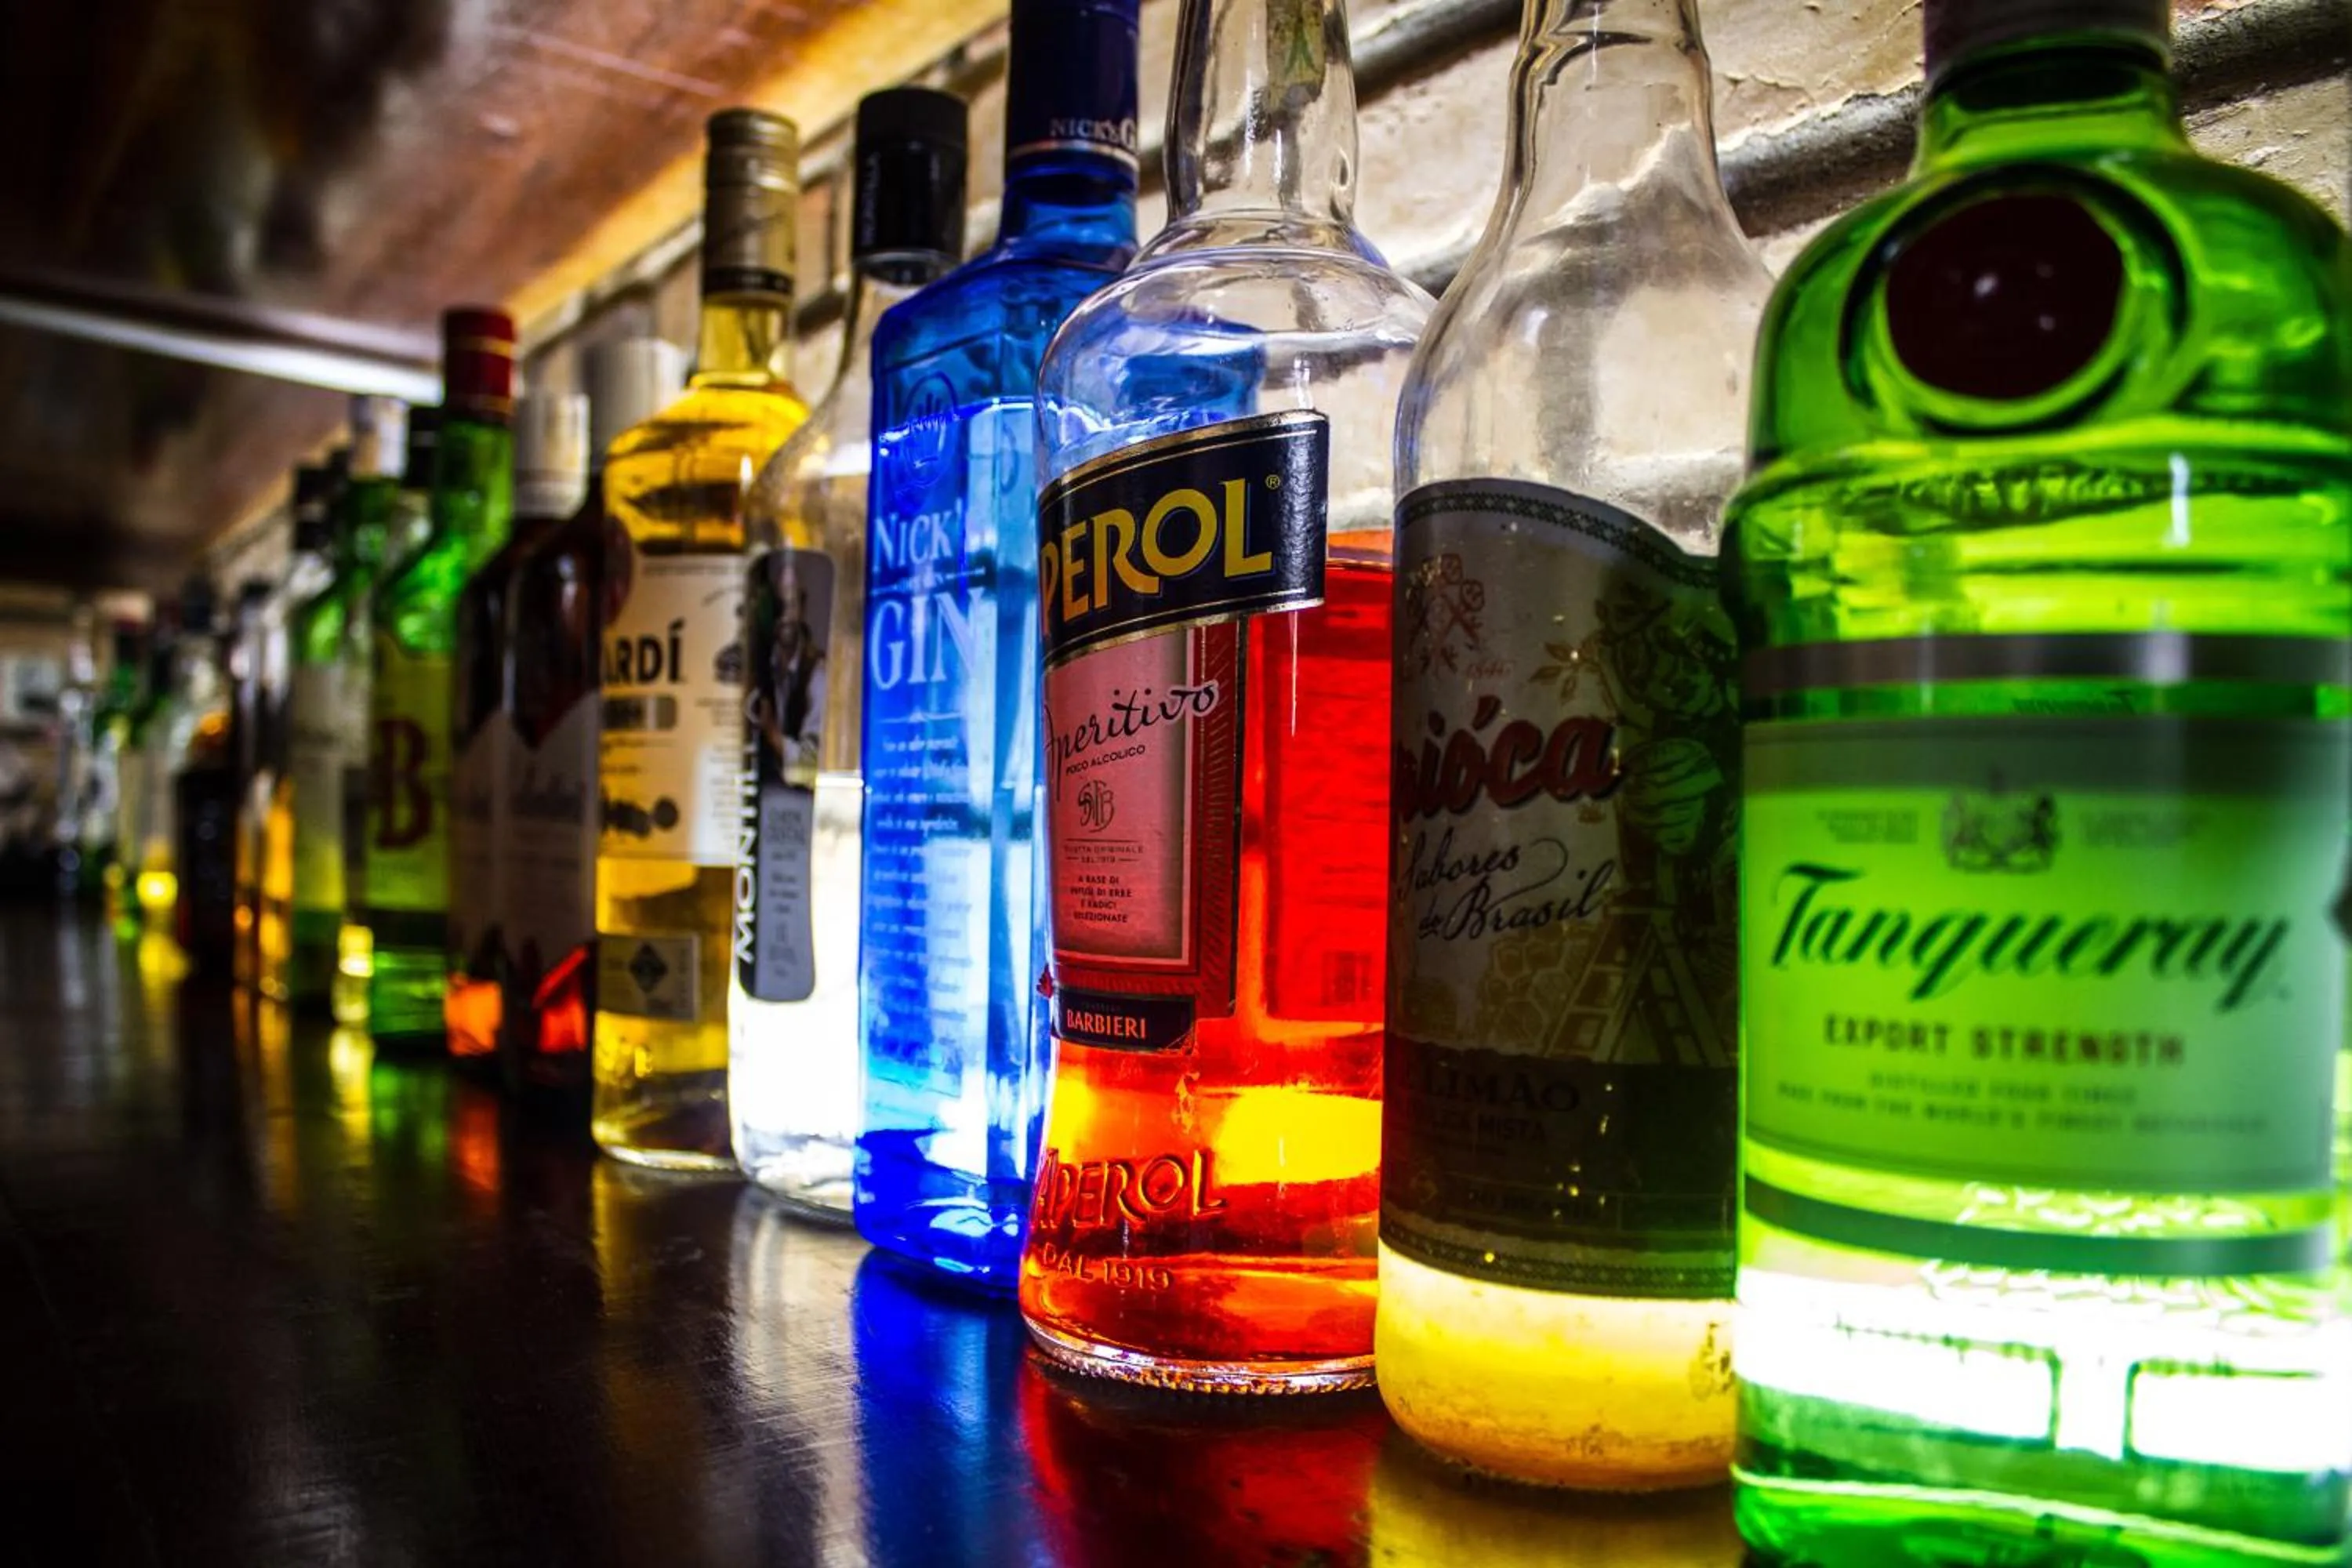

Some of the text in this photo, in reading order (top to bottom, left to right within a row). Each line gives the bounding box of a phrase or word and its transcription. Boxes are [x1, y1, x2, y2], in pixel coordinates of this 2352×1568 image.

[870, 587, 986, 691] GIN
[1044, 684, 1216, 802] Aperitivo
[1065, 744, 1146, 776] POCO ALCOLICO
[1769, 862, 2289, 1015] Tanqueray
[1066, 1008, 1147, 1041] BARBIERI
[1823, 1012, 2187, 1070] EXPORT STRENGTH
